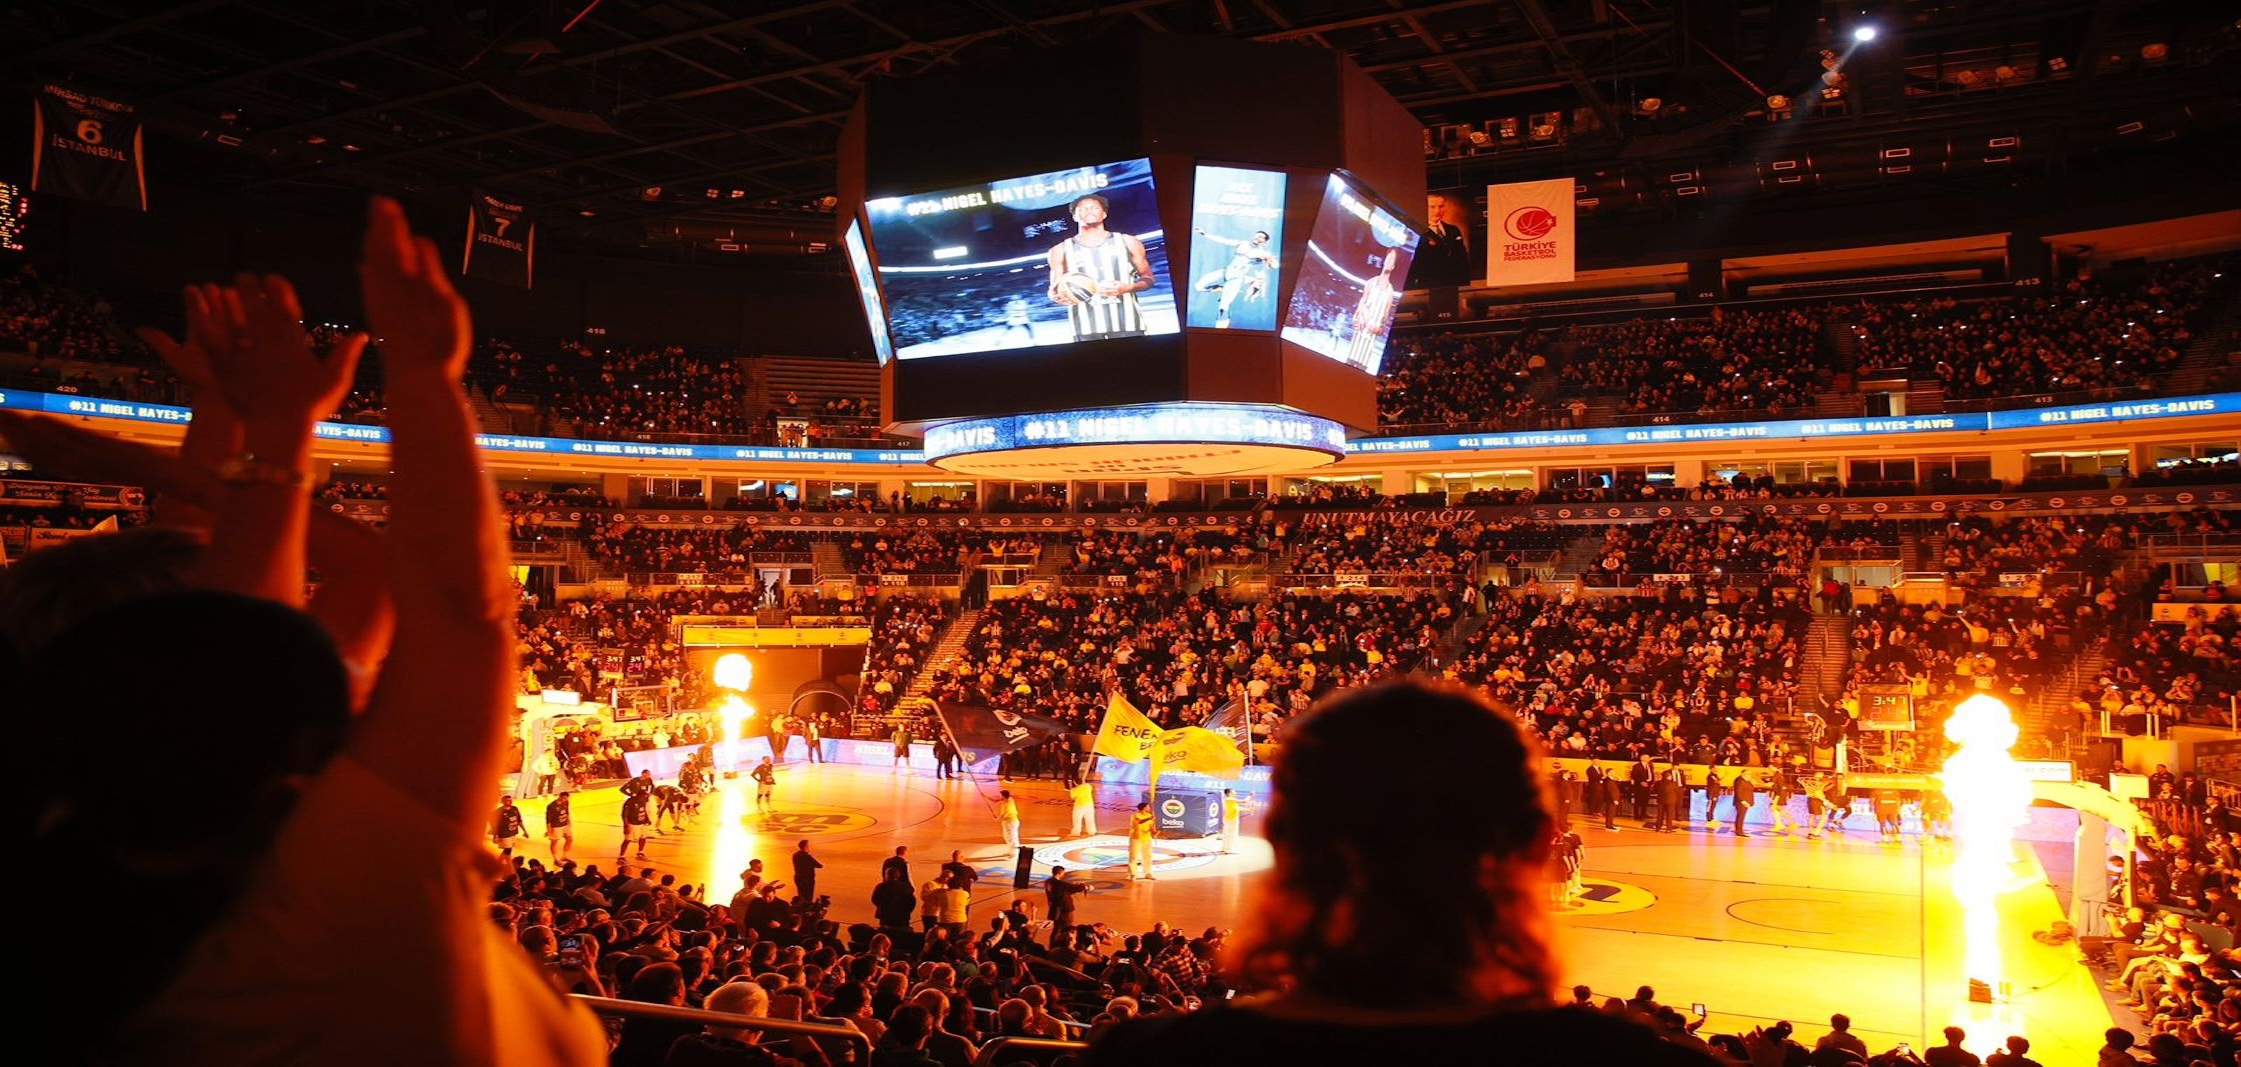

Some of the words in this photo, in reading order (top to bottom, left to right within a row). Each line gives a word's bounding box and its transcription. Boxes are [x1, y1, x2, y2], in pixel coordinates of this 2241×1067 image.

[77, 118, 104, 144] 6
[51, 132, 128, 161] İSTANBUL
[941, 191, 987, 211] NIGEL
[990, 173, 1109, 203] HAYES-DAVIS
[494, 217, 511, 238] 7
[1503, 240, 1557, 252] TÜRKİYE
[1503, 248, 1557, 257] BASKETBOL
[2015, 277, 2040, 286] 413
[56, 385, 78, 393] 420
[69, 400, 96, 412] #11
[100, 403, 135, 416] NIGEL
[138, 406, 192, 421] HAYES-D
[2040, 411, 2068, 422] #11
[2071, 407, 2109, 420] NIGEL
[2112, 399, 2215, 417] HAYES-DAVIS
[1653, 415, 1670, 423] 414
[1024, 420, 1071, 441] #11
[1078, 416, 1147, 438] NIGEL
[1157, 415, 1314, 441] HAYES-DAVIS
[1801, 423, 1826, 434] #11
[1828, 422, 1862, 433] NIGEL
[1865, 418, 1954, 431] HAYES-DAVIS
[314, 427, 381, 439] AYES-DAVIS
[1626, 431, 1649, 441] #11
[1652, 429, 1683, 439] NIGEL
[1685, 426, 1767, 438] HAYES-DAVIS
[475, 436, 546, 449] HAYES-DAVIS
[1362, 439, 1430, 451] HAYES-DAVIS
[1458, 438, 1480, 447] #11
[1482, 437, 1511, 446] NIGEL
[1514, 433, 1588, 445] HAYES-DAVIS
[595, 444, 622, 453] NIGEL
[624, 445, 693, 456] HAYES-DAVIS
[759, 450, 784, 459] NIGEL
[787, 451, 852, 460] HAYES-DAVIS
[1302, 507, 1477, 526] UNUTMAYACAĞIZ
[1872, 696, 1907, 706] 3:47
[1161, 818, 1185, 827] beko
